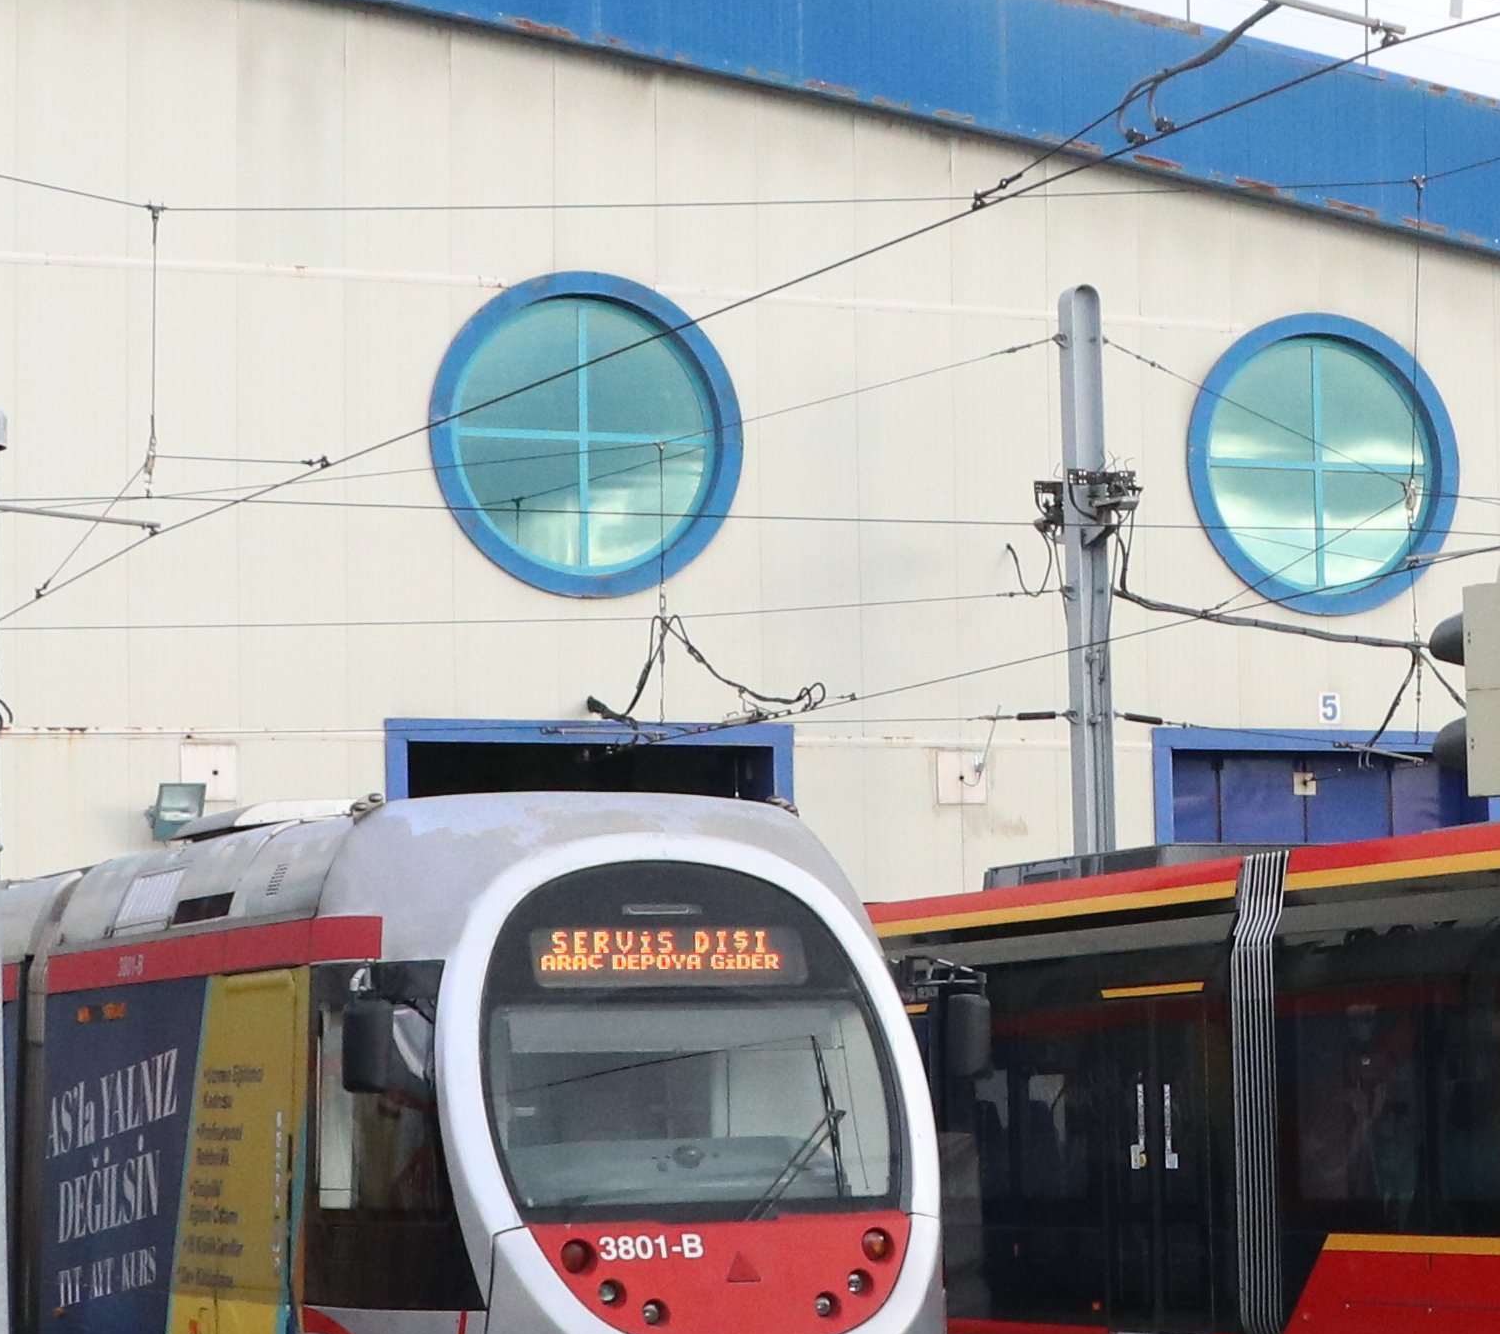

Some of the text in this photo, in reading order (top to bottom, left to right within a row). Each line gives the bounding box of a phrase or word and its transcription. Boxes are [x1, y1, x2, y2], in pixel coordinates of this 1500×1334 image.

[1322, 694, 1338, 721] 5
[612, 953, 701, 971] DEPOYA
[100, 1048, 179, 1140] YALNIZ
[57, 1133, 161, 1244] DEĞİLSİN
[599, 1233, 704, 1261] 3801-B
[121, 1245, 157, 1291] KURS
